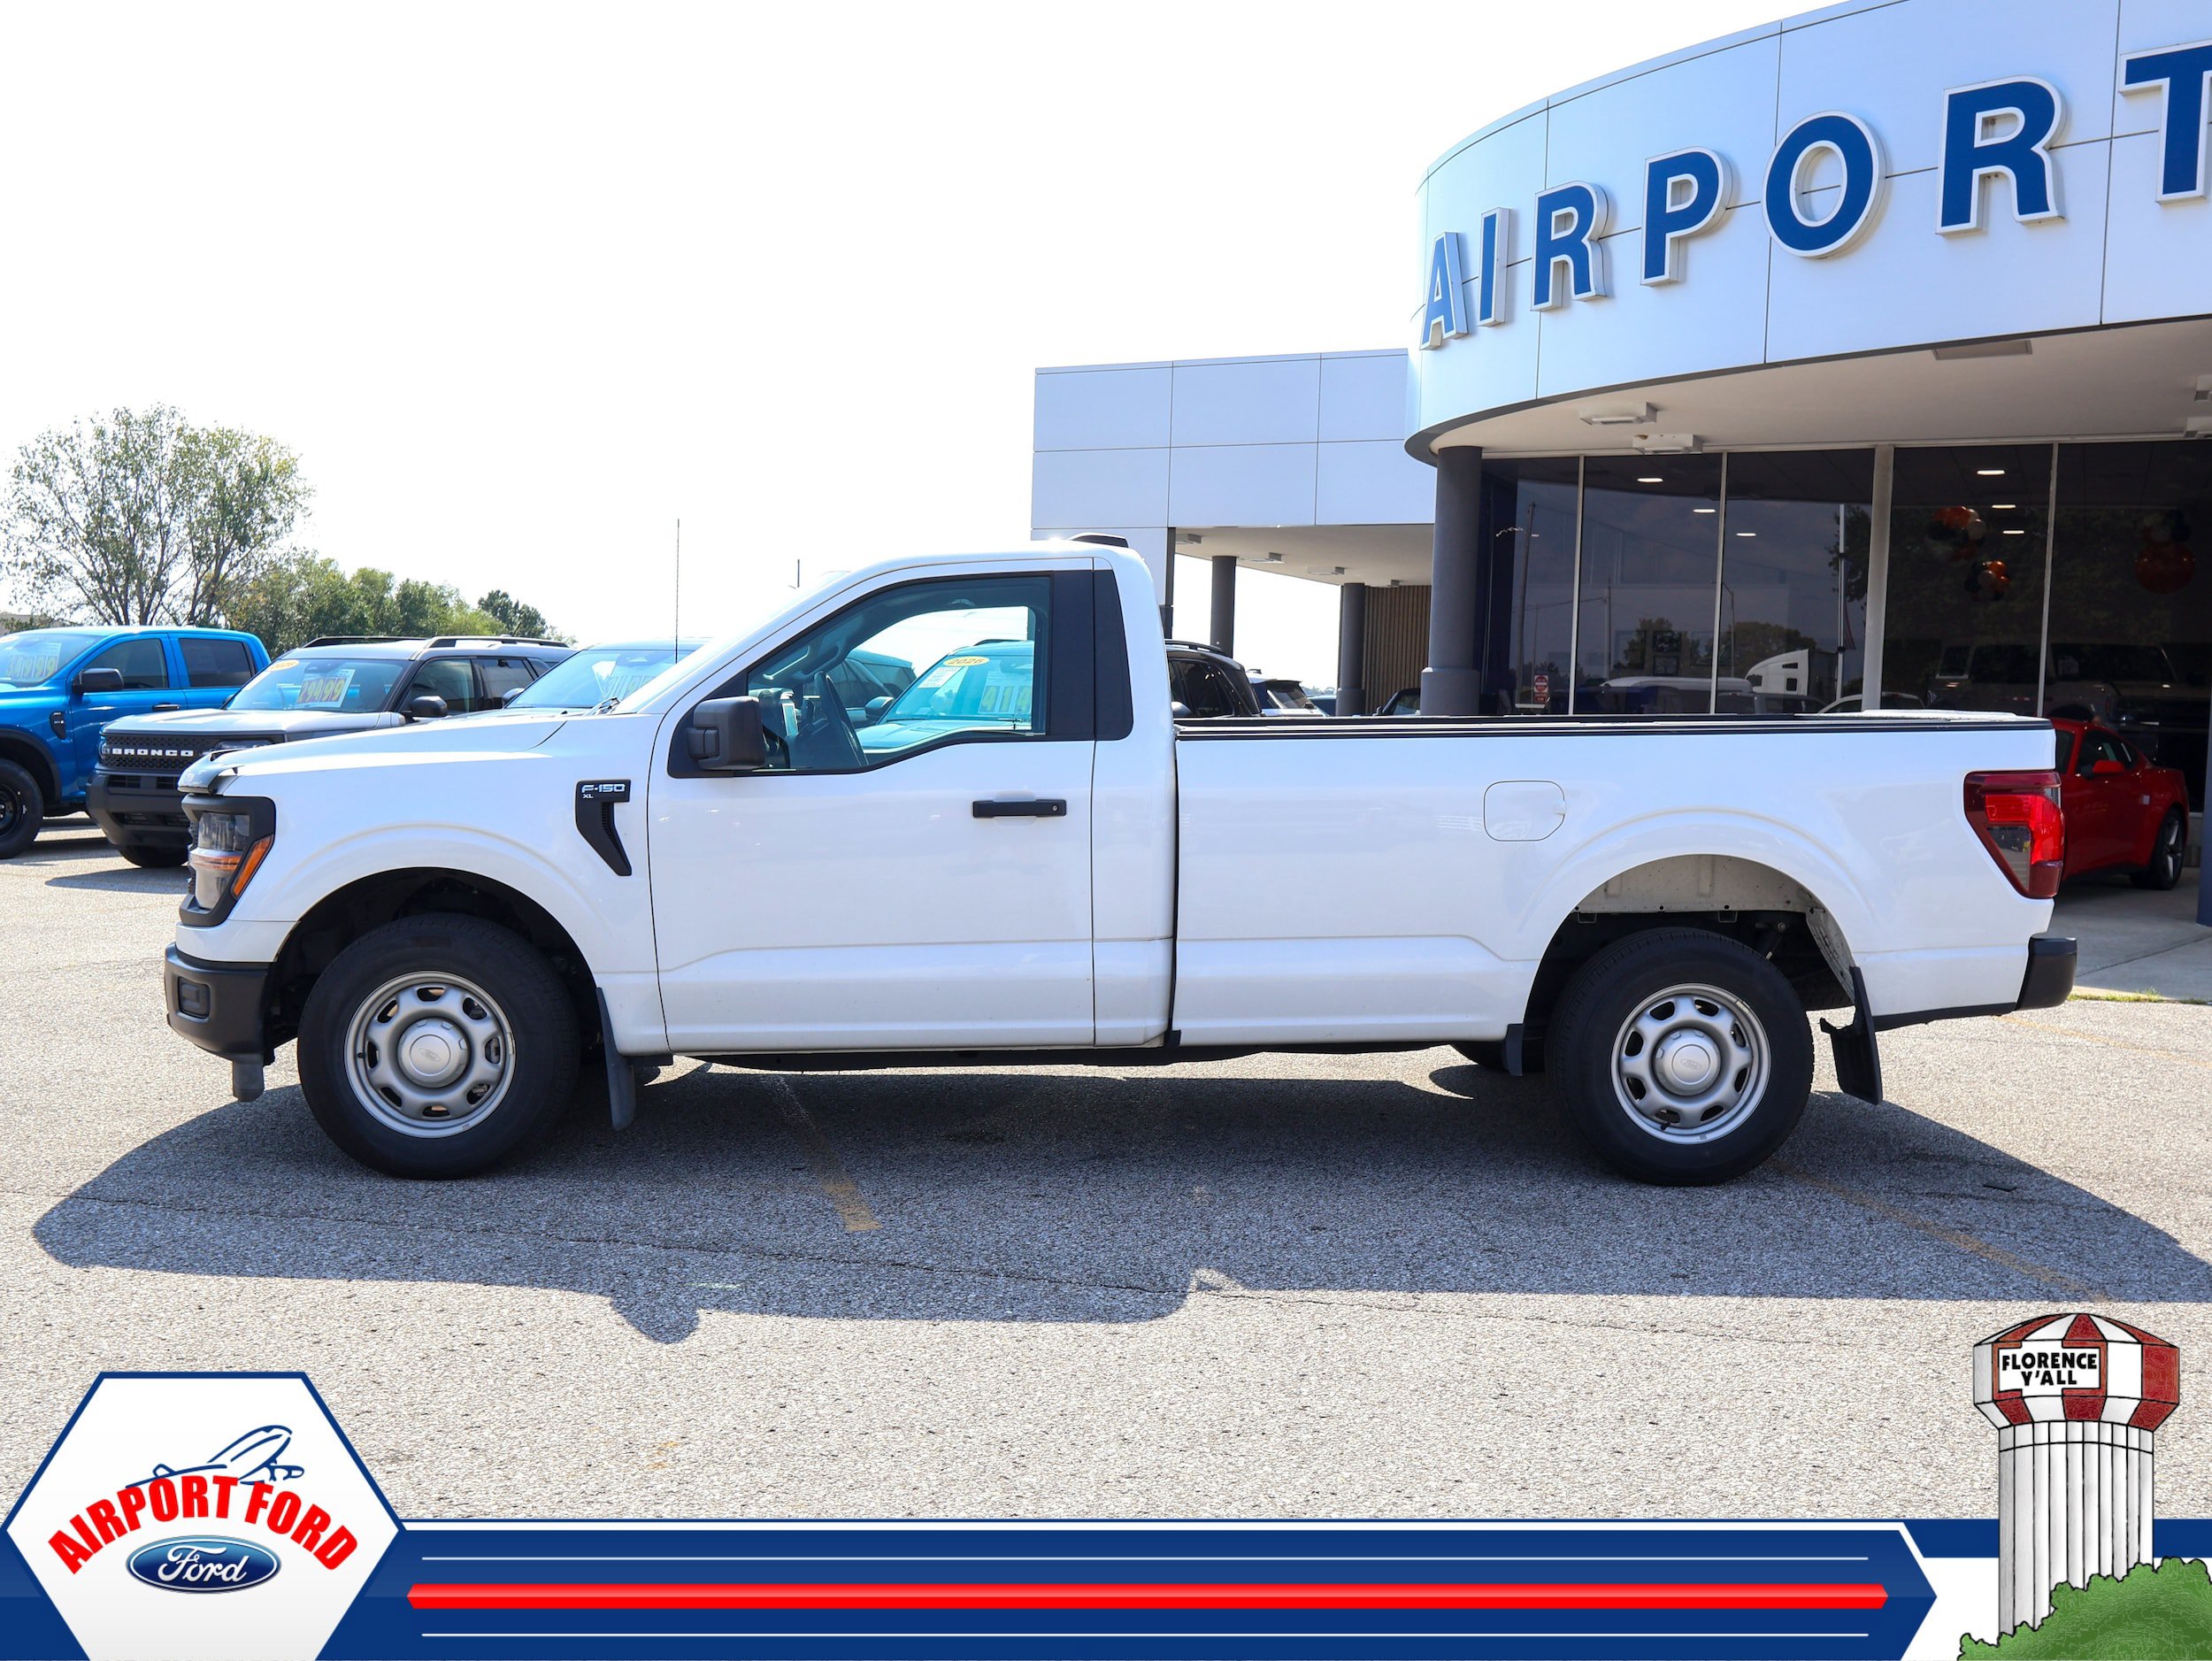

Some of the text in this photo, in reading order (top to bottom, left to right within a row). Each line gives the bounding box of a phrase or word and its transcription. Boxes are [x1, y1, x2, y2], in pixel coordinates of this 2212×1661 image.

[1420, 41, 2212, 350] AIRPORT
[111, 748, 194, 757] BRONCO
[581, 783, 626, 793] F-150
